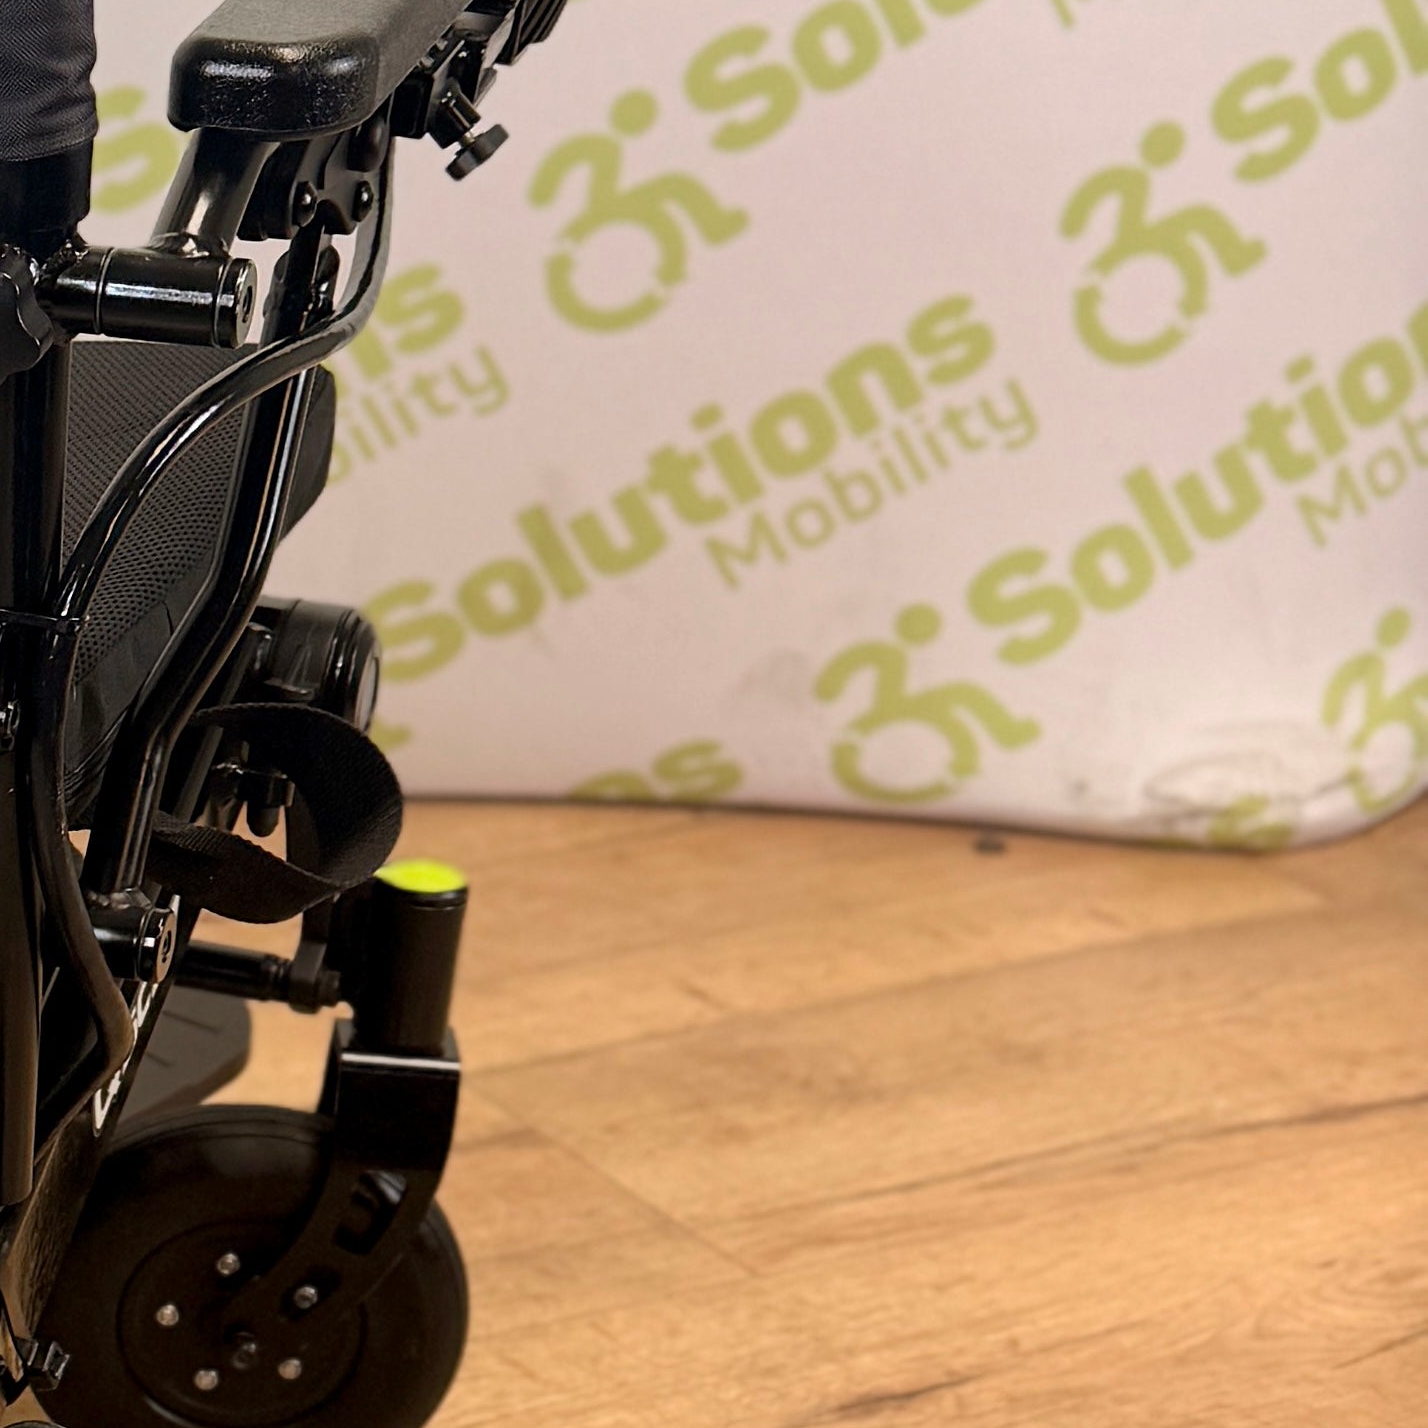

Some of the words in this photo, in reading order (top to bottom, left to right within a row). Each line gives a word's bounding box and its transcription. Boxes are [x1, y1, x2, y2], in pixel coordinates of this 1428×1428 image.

[361, 295, 995, 684] Solutions
[706, 382, 1037, 584] Mobility
[967, 304, 1428, 667] Solutio
